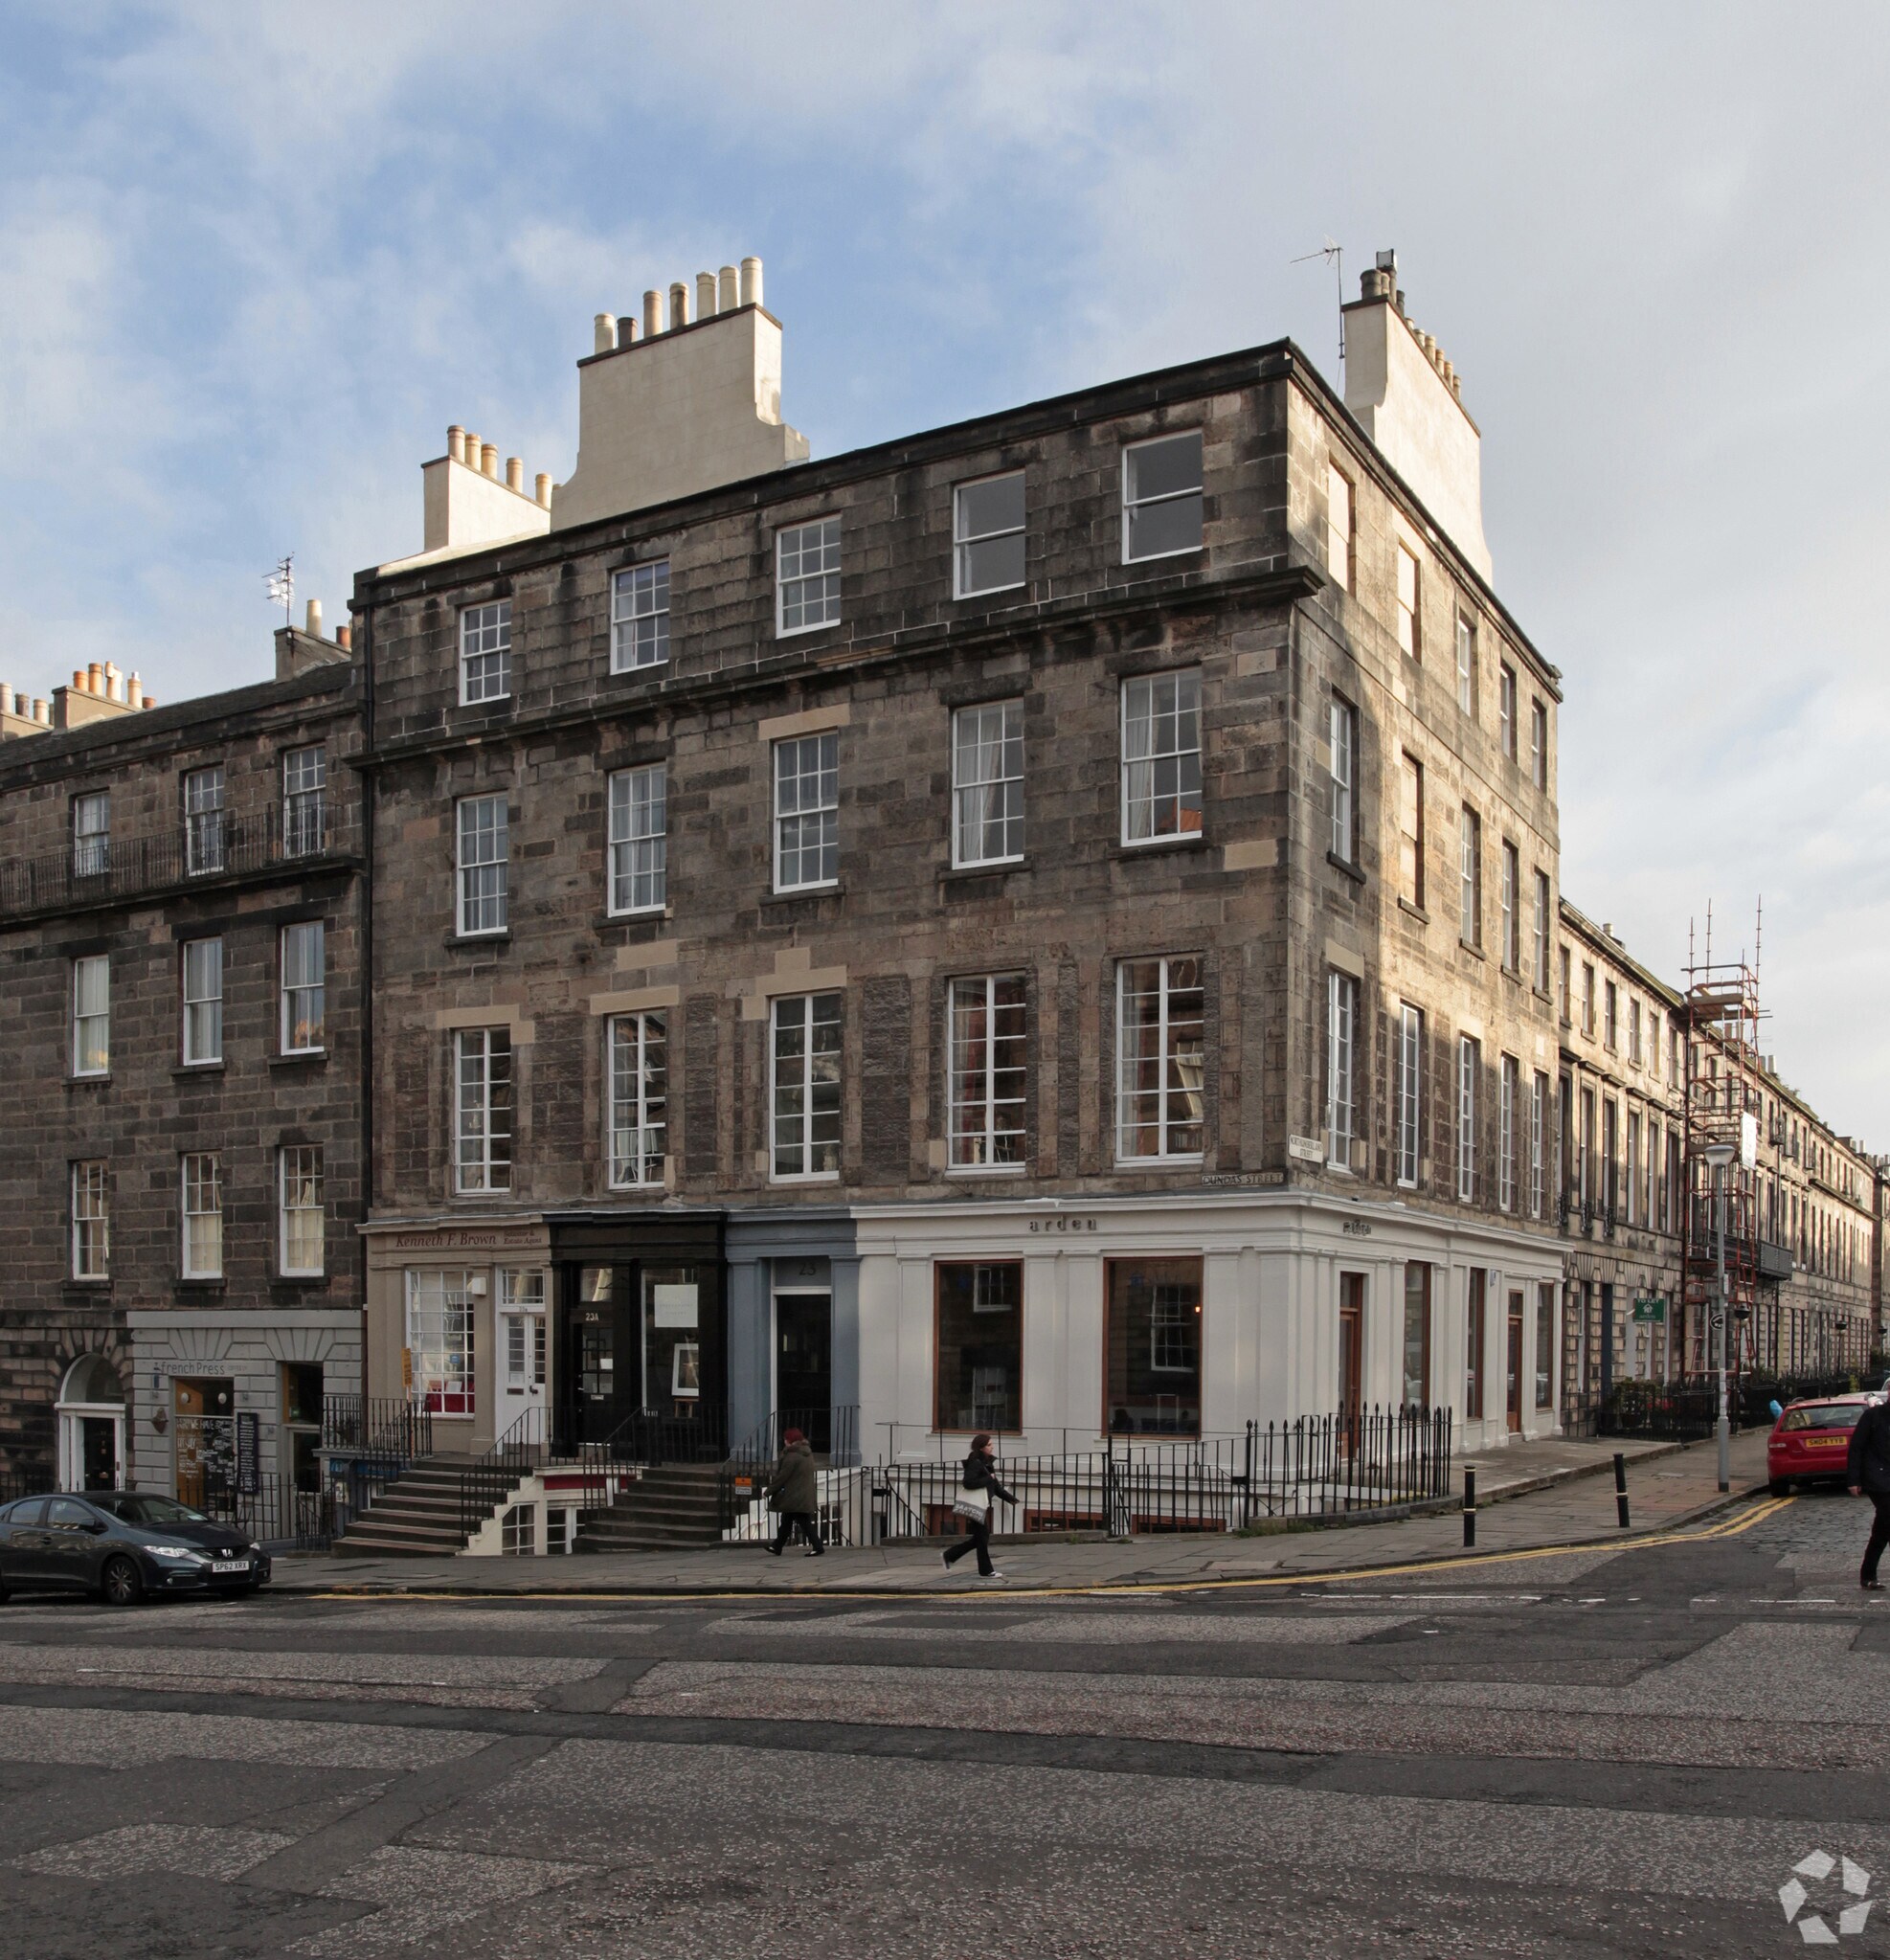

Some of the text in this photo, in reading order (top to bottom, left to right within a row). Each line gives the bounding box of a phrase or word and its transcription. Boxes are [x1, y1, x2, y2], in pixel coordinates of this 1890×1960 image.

[1299, 1148, 1314, 1159] STREET
[1203, 1173, 1282, 1185] DUNDAS STREET
[1029, 1214, 1097, 1232] arden
[395, 1231, 497, 1248] Kenneth F. Brown
[799, 1262, 817, 1276] 23
[585, 1312, 599, 1321] 23A
[161, 1362, 194, 1375] french
[196, 1362, 225, 1375] Press
[214, 1563, 234, 1571] SP62
